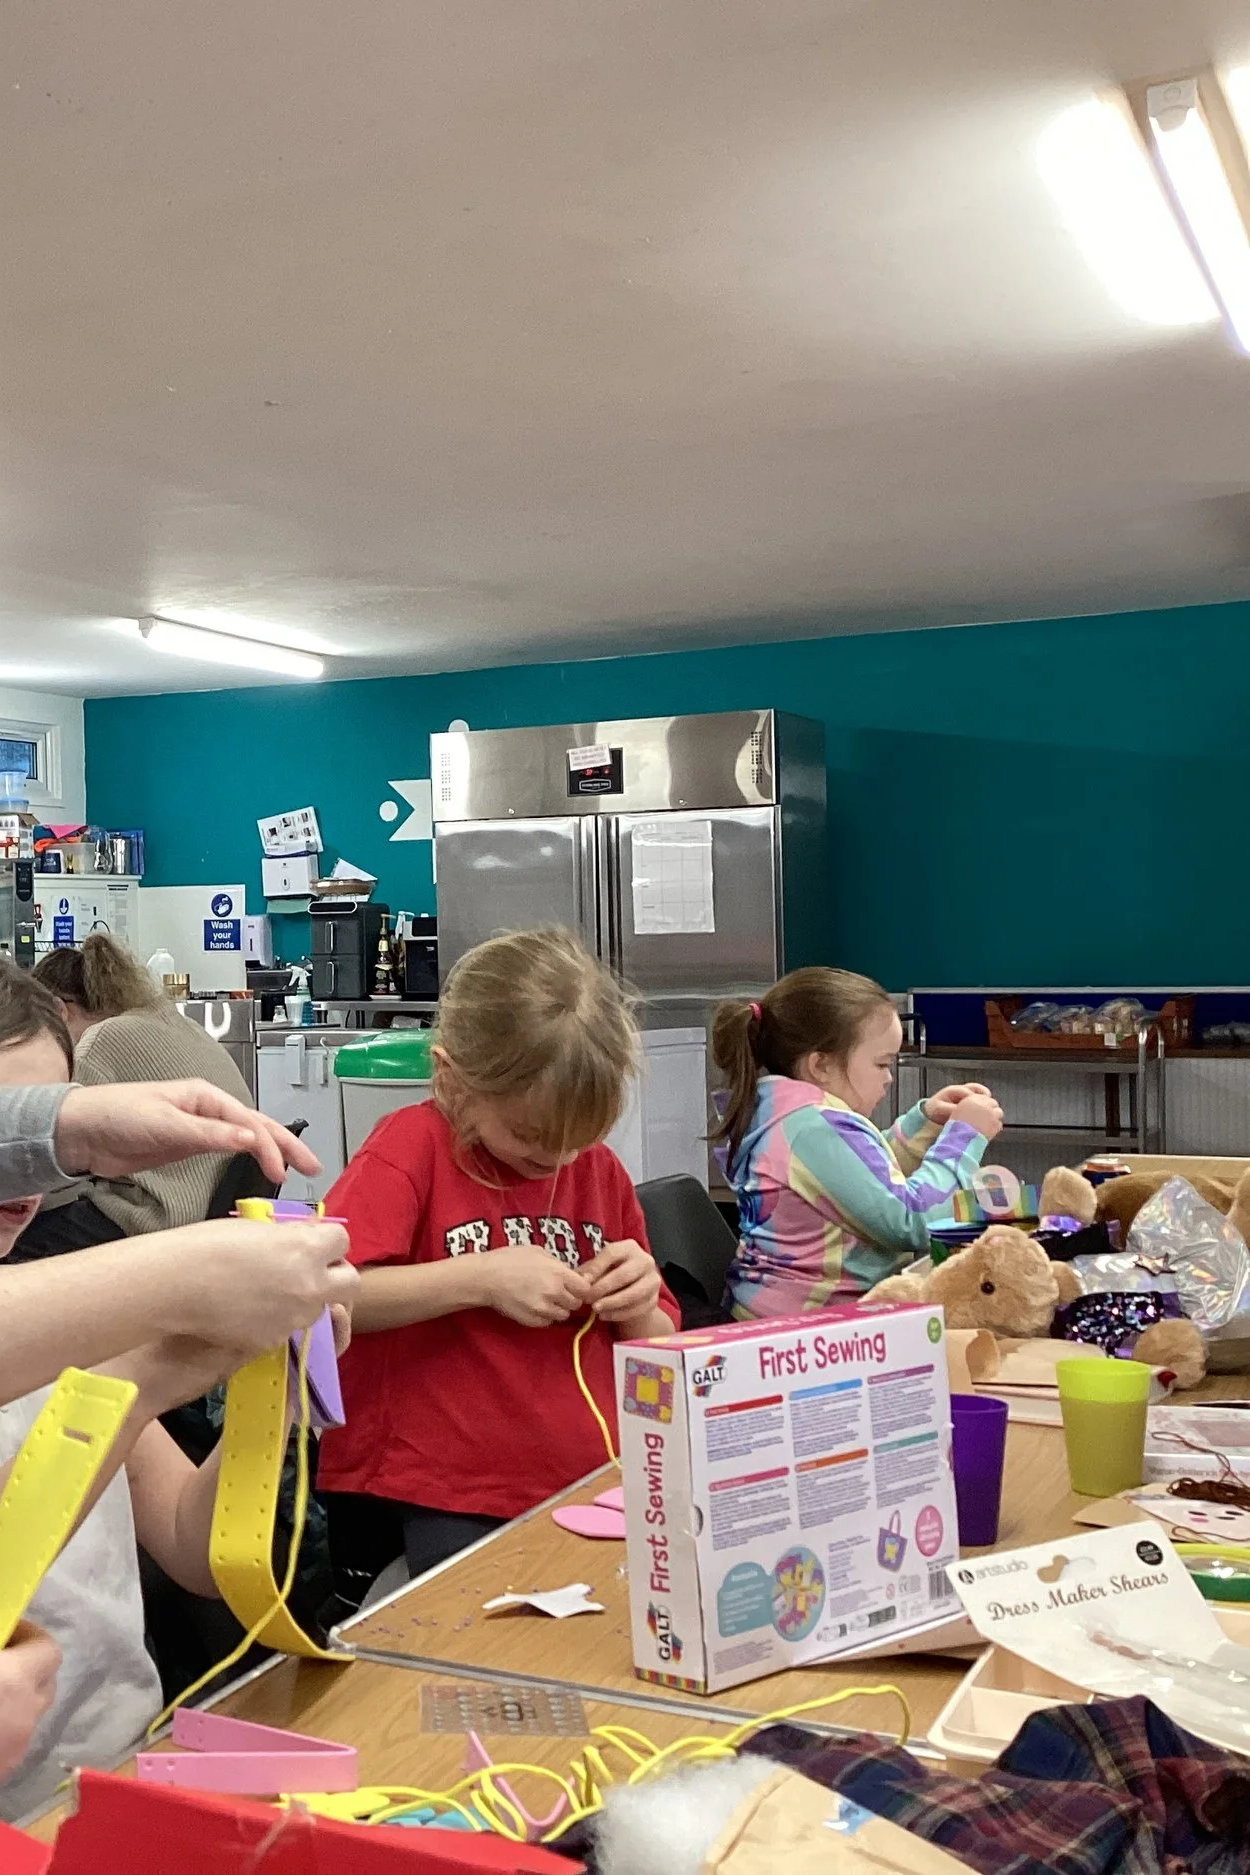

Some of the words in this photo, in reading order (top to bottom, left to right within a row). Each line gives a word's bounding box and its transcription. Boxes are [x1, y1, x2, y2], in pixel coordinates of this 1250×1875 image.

[210, 941, 235, 949] hands
[211, 921, 233, 929] Wash
[213, 932, 231, 941] your
[692, 1367, 724, 1386] GALT
[759, 1338, 809, 1380] First
[813, 1331, 887, 1369] Sewing
[644, 1432, 666, 1526] Sewing
[646, 1533, 671, 1594] First
[986, 1600, 1040, 1621] Dress
[1046, 1583, 1108, 1610] Maker
[1109, 1572, 1169, 1595] Shears
[657, 1611, 671, 1661] GALT
